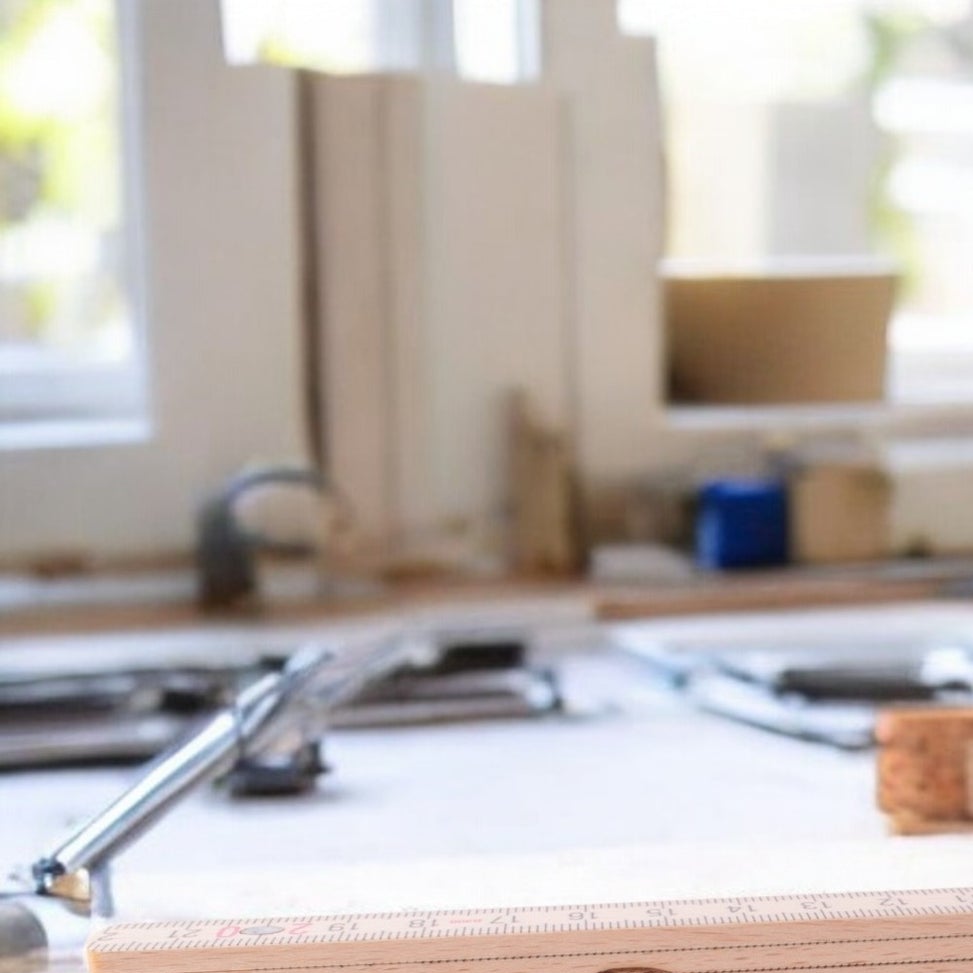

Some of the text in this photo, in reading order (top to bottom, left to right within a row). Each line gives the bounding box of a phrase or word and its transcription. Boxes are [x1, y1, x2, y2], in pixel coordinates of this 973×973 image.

[800, 901, 832, 911] 13
[880, 898, 909, 907] 12
[646, 908, 678, 918] 15
[728, 904, 758, 914] 14
[489, 915, 520, 925] 17
[568, 911, 599, 921] 16
[328, 922, 360, 933] 19
[408, 919, 440, 929] 18
[168, 929, 201, 939] 21
